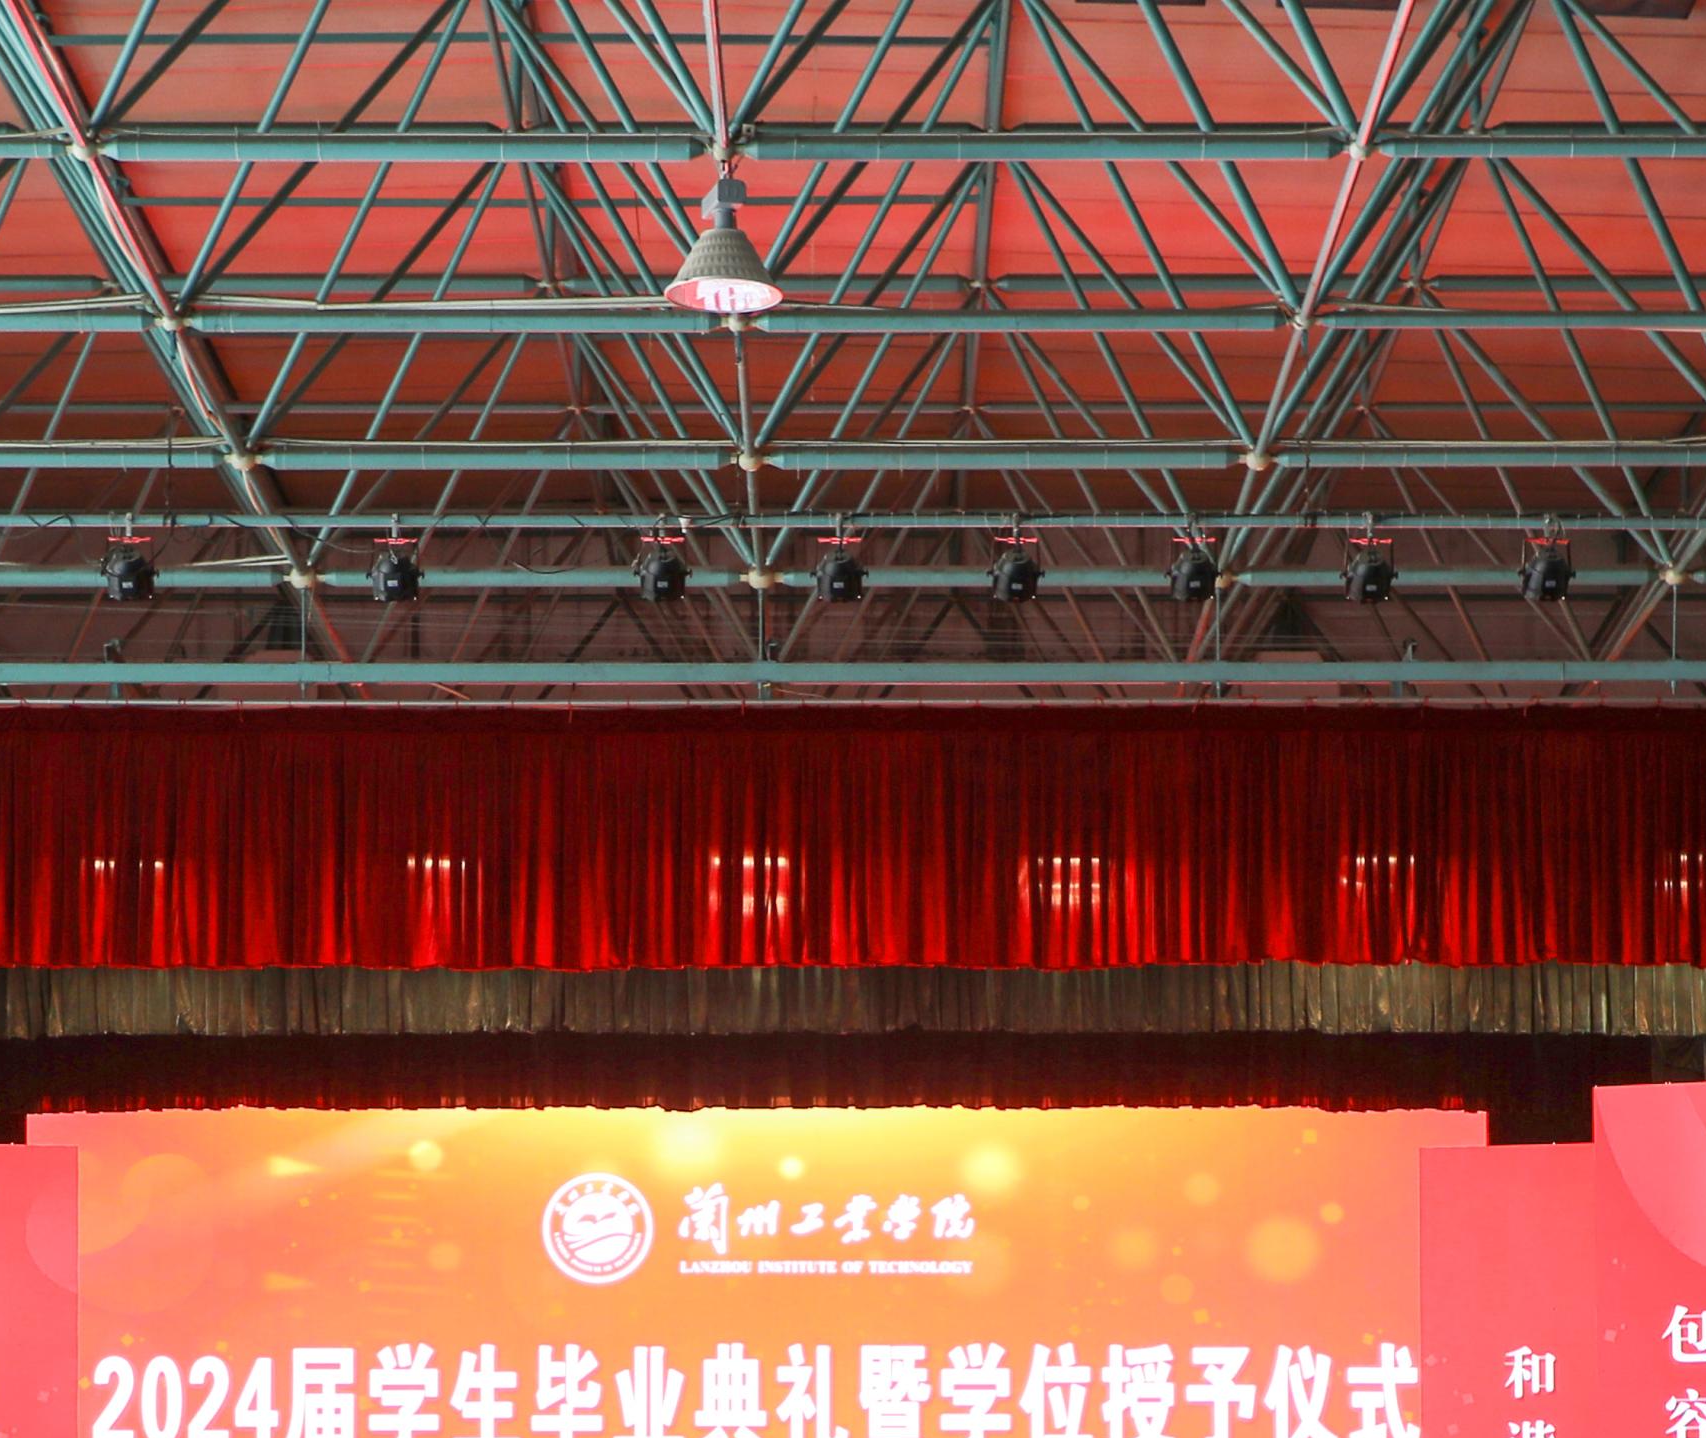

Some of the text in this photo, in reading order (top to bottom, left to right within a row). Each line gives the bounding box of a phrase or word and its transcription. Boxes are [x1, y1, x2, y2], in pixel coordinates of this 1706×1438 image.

[679, 1260, 974, 1275] LANZHOU INSTITUTE OF TECHNOLOGY
